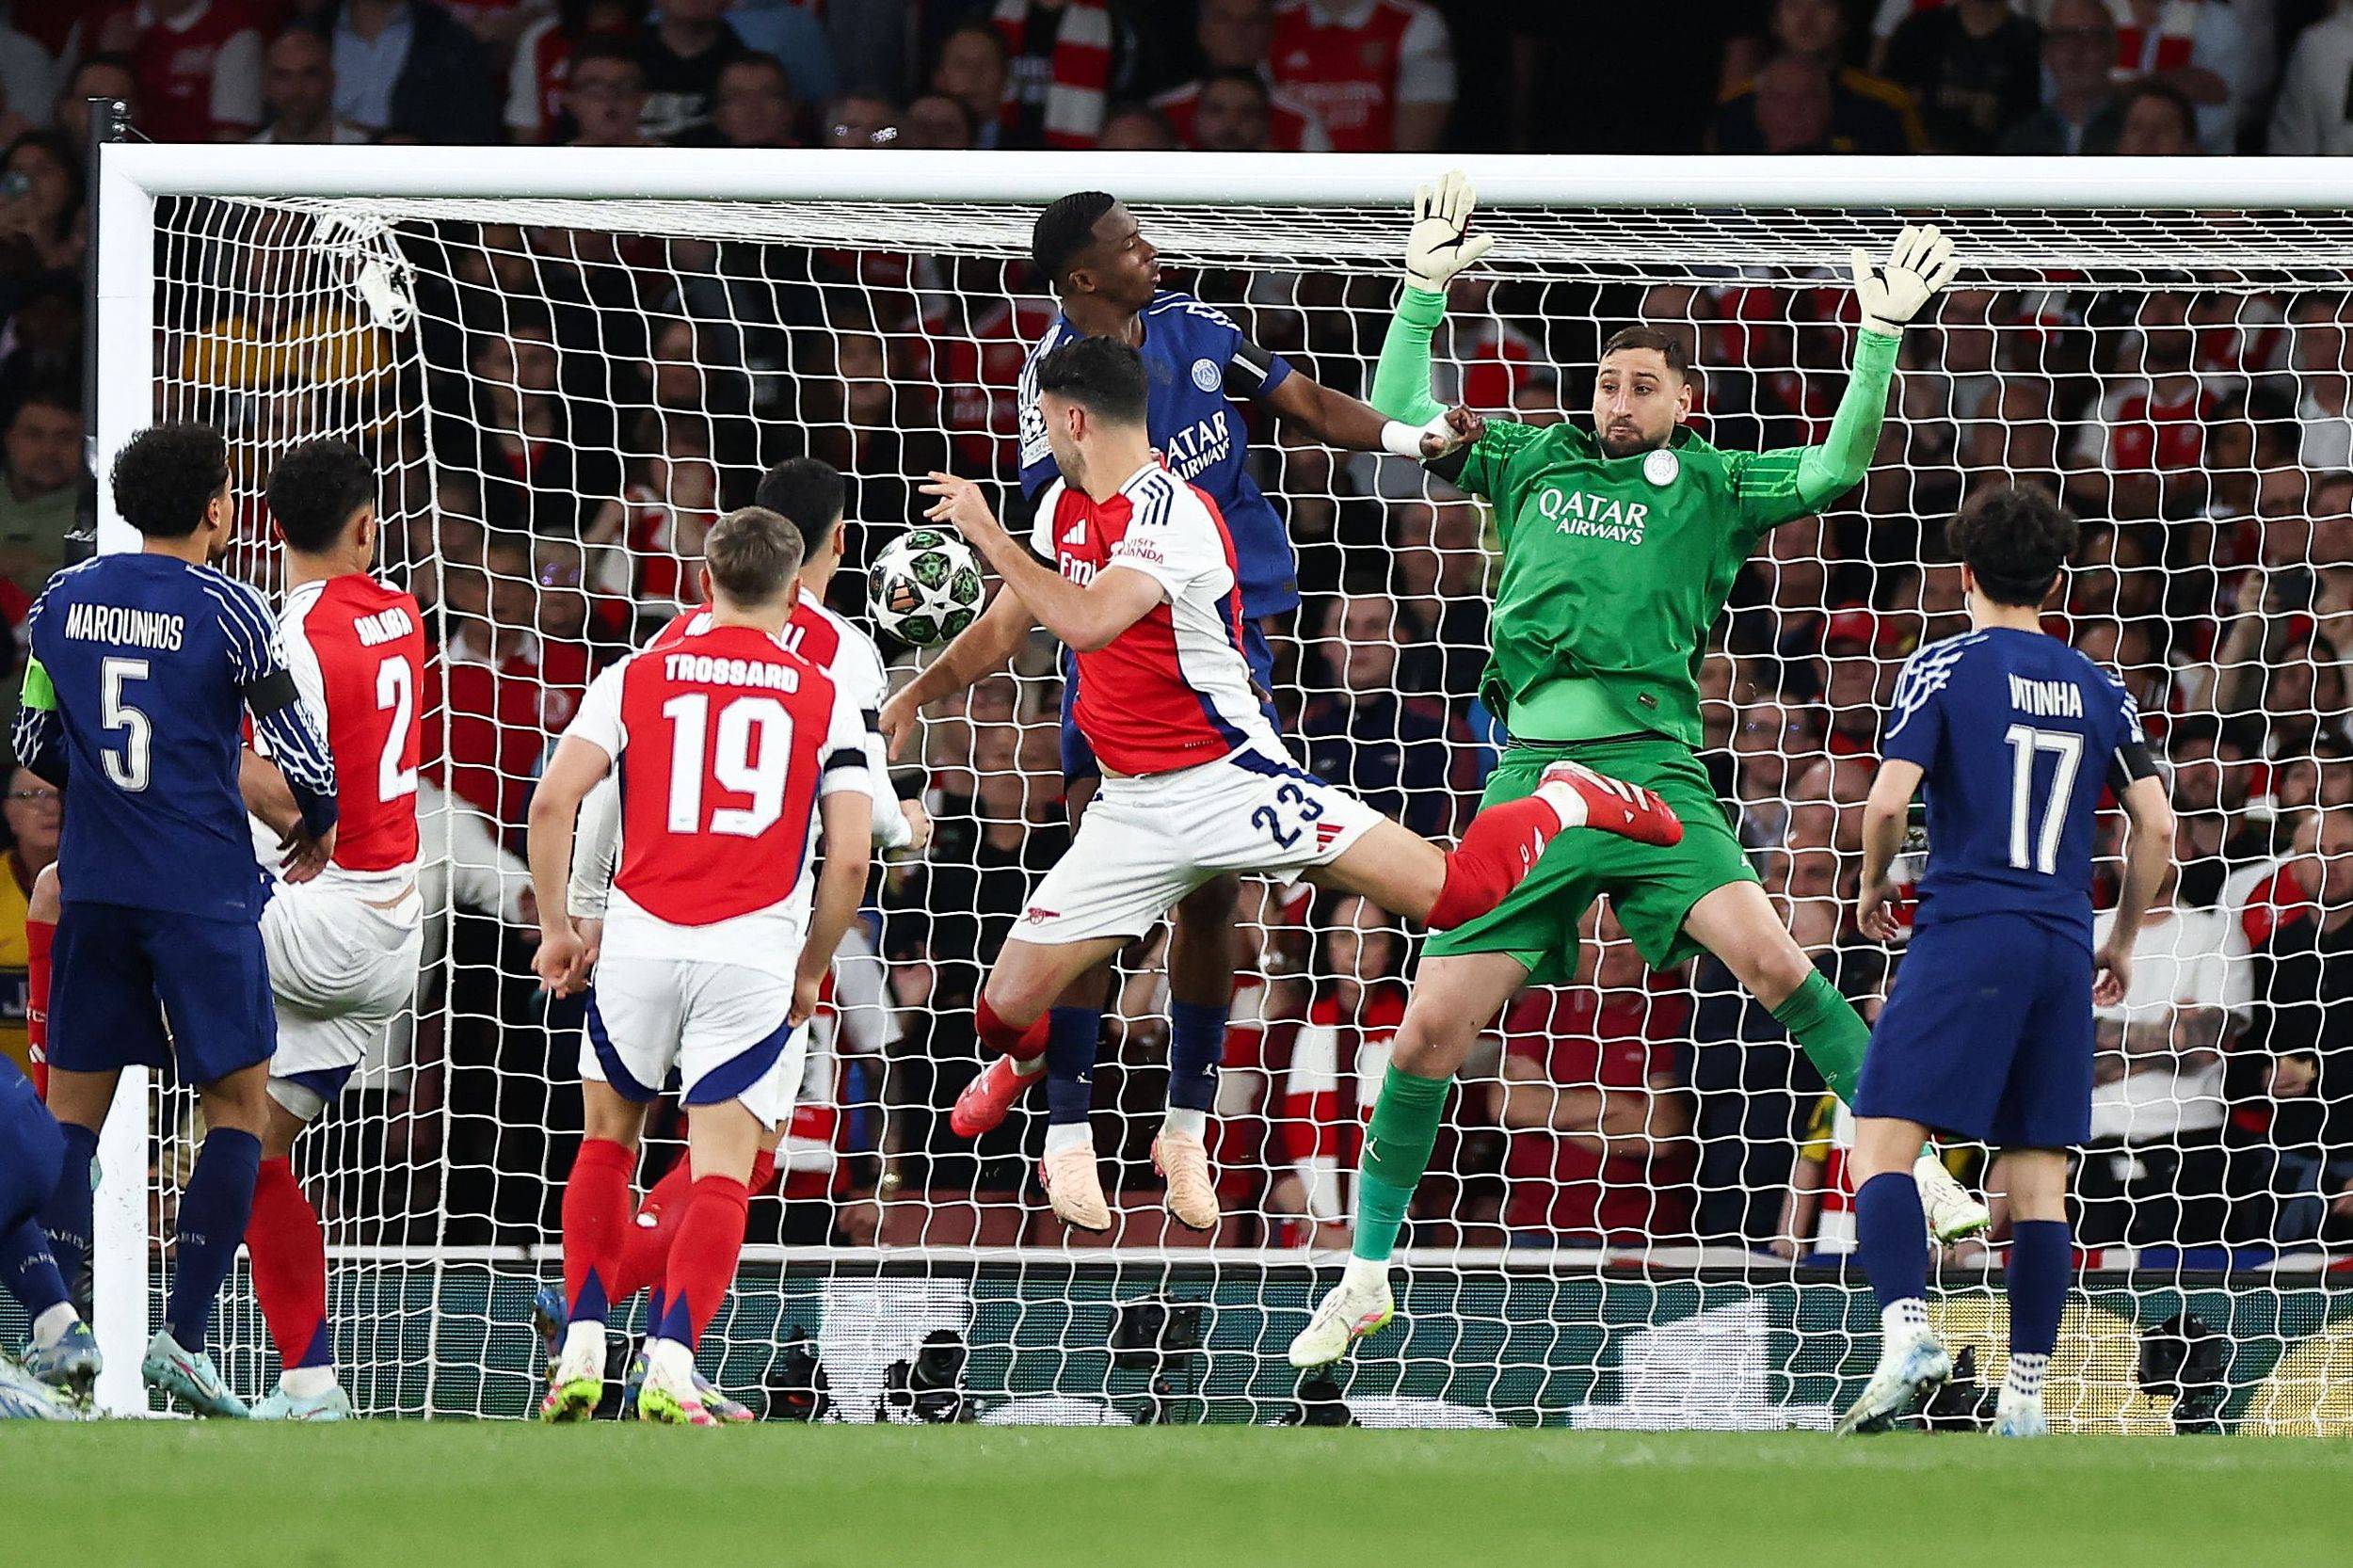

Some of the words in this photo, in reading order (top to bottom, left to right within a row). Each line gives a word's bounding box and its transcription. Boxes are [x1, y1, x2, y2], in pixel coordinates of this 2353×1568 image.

[1166, 410, 1228, 468] ATAR
[1539, 488, 1648, 529] QATAR
[1555, 517, 1643, 546] AIRWAYS
[664, 653, 799, 695] TROSSARD
[2008, 672, 2084, 719] VITINHA
[101, 656, 152, 792] 5
[376, 654, 418, 803] 2
[663, 692, 794, 840] 19
[1252, 783, 1324, 851] 23
[2004, 723, 2084, 875] 17
